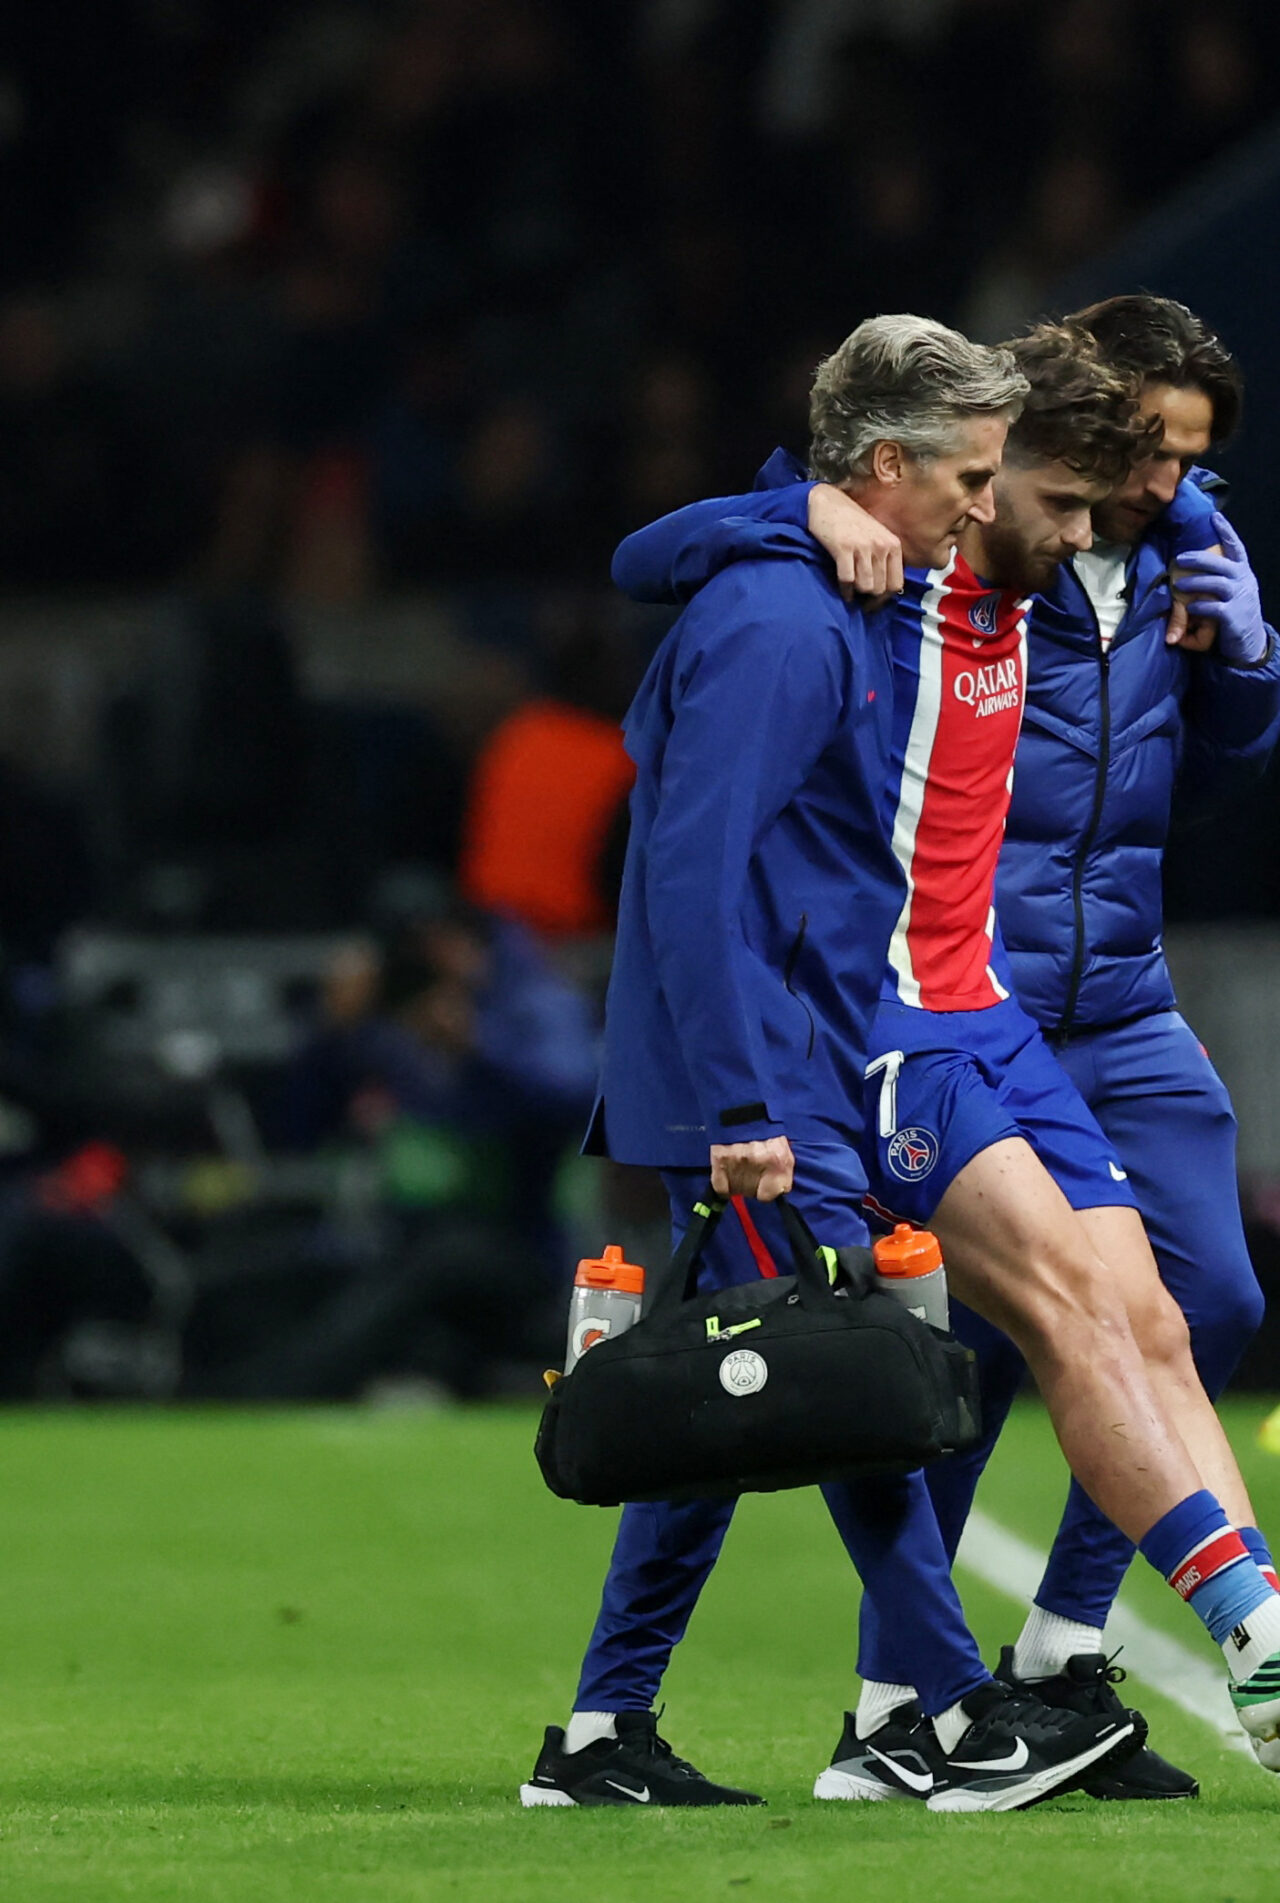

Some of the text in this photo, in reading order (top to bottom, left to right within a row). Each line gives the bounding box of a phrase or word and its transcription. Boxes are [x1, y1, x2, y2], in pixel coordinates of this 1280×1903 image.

[954, 658, 1018, 706] QATAR
[975, 688, 1019, 718] AIRWAYS
[891, 1130, 918, 1156] PARIS
[728, 1353, 756, 1365] PARIS
[1175, 1566, 1202, 1596] PARIS
